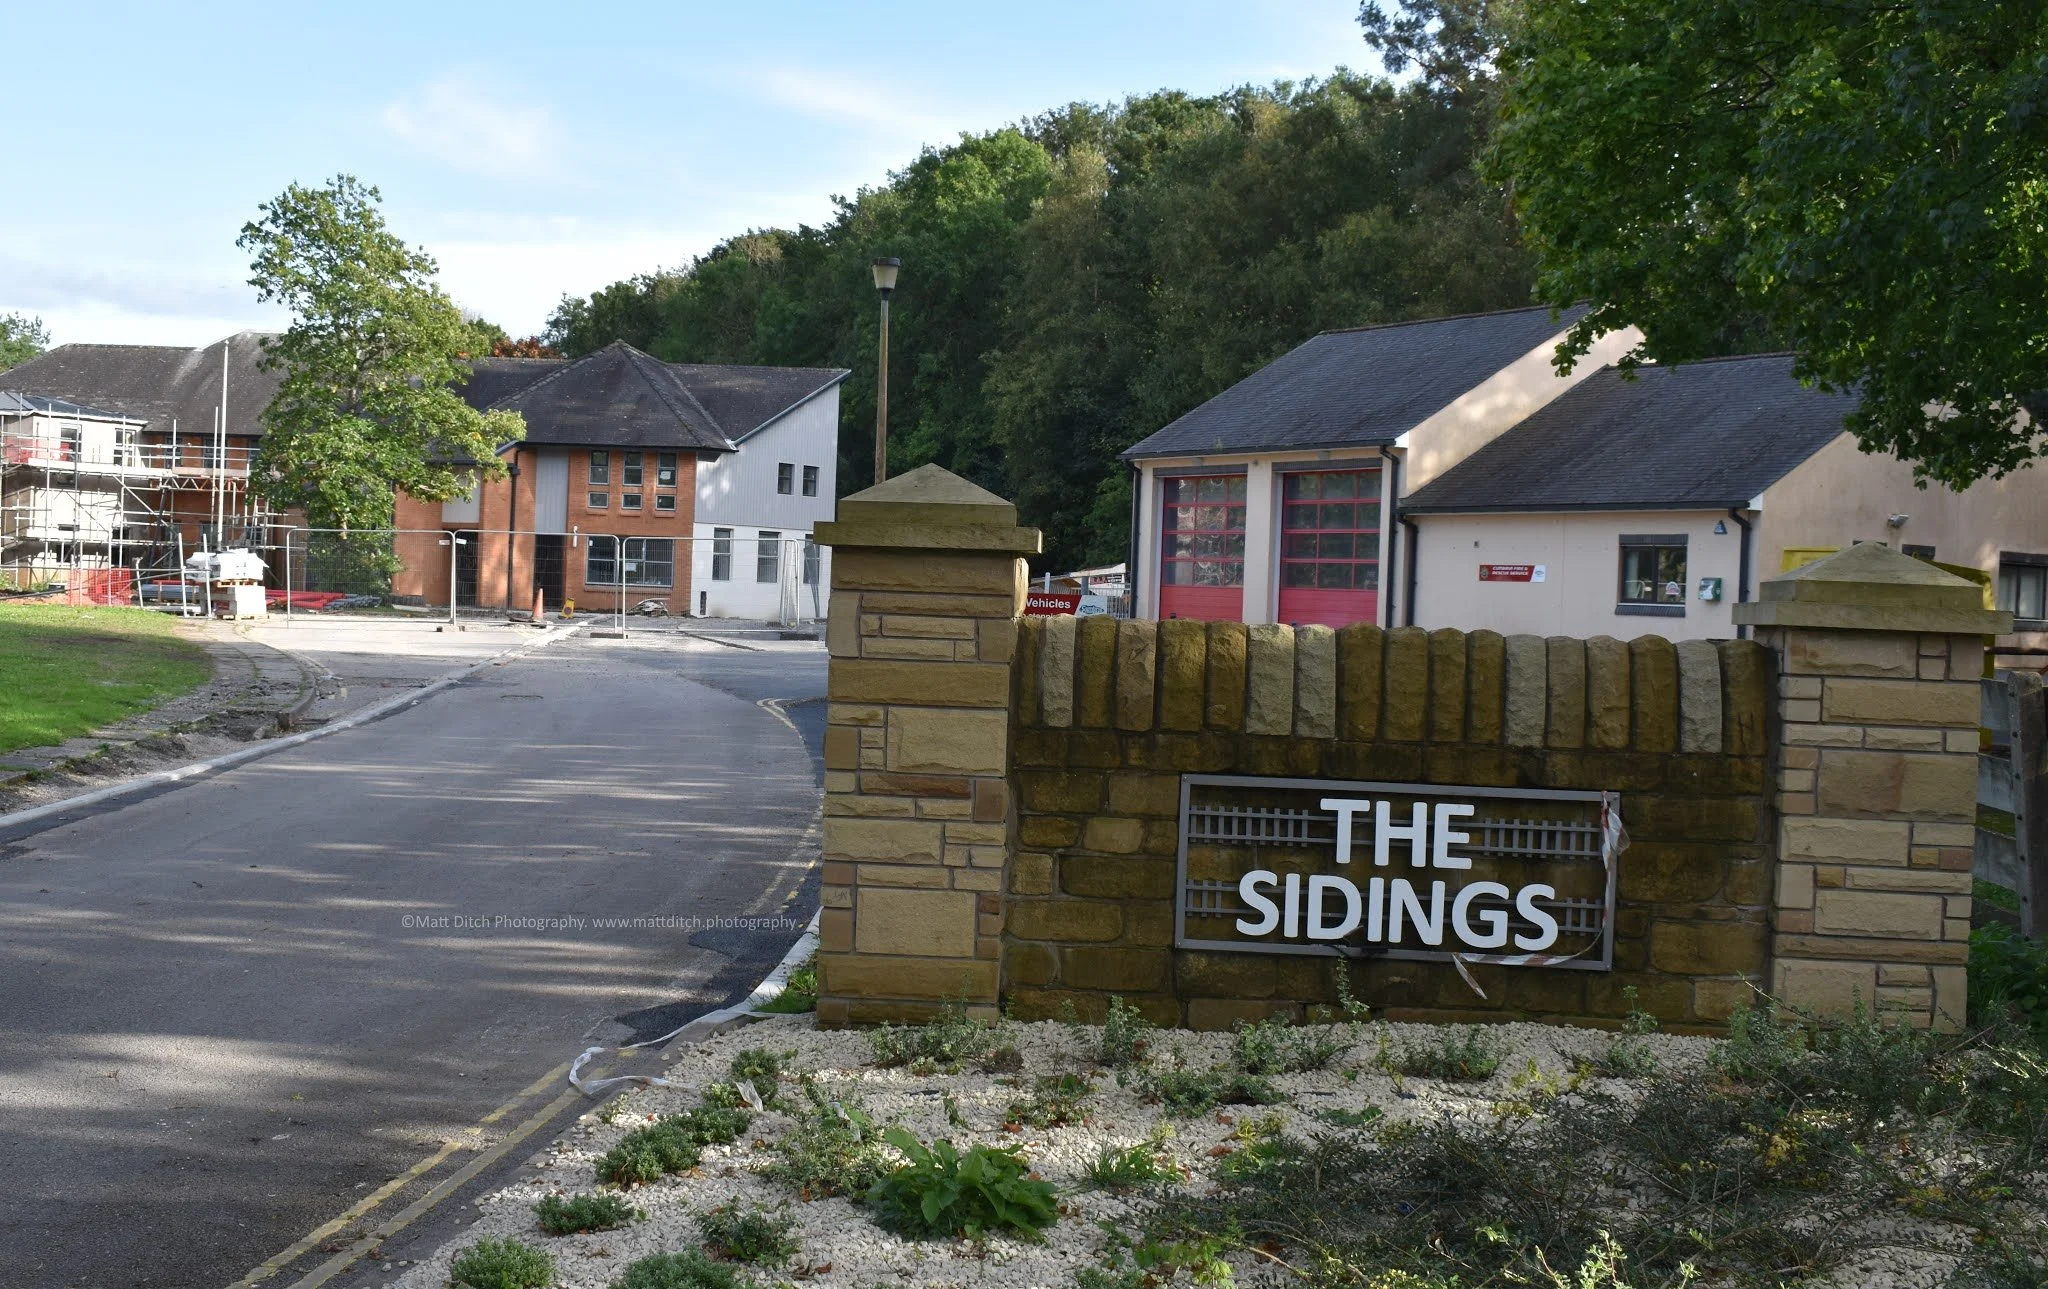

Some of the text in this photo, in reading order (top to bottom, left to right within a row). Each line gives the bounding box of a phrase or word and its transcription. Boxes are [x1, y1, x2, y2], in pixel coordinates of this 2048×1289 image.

[1026, 598, 1071, 608] Vehicles
[1320, 797, 1475, 870] THE
[1235, 869, 1559, 951] SIDINGS
